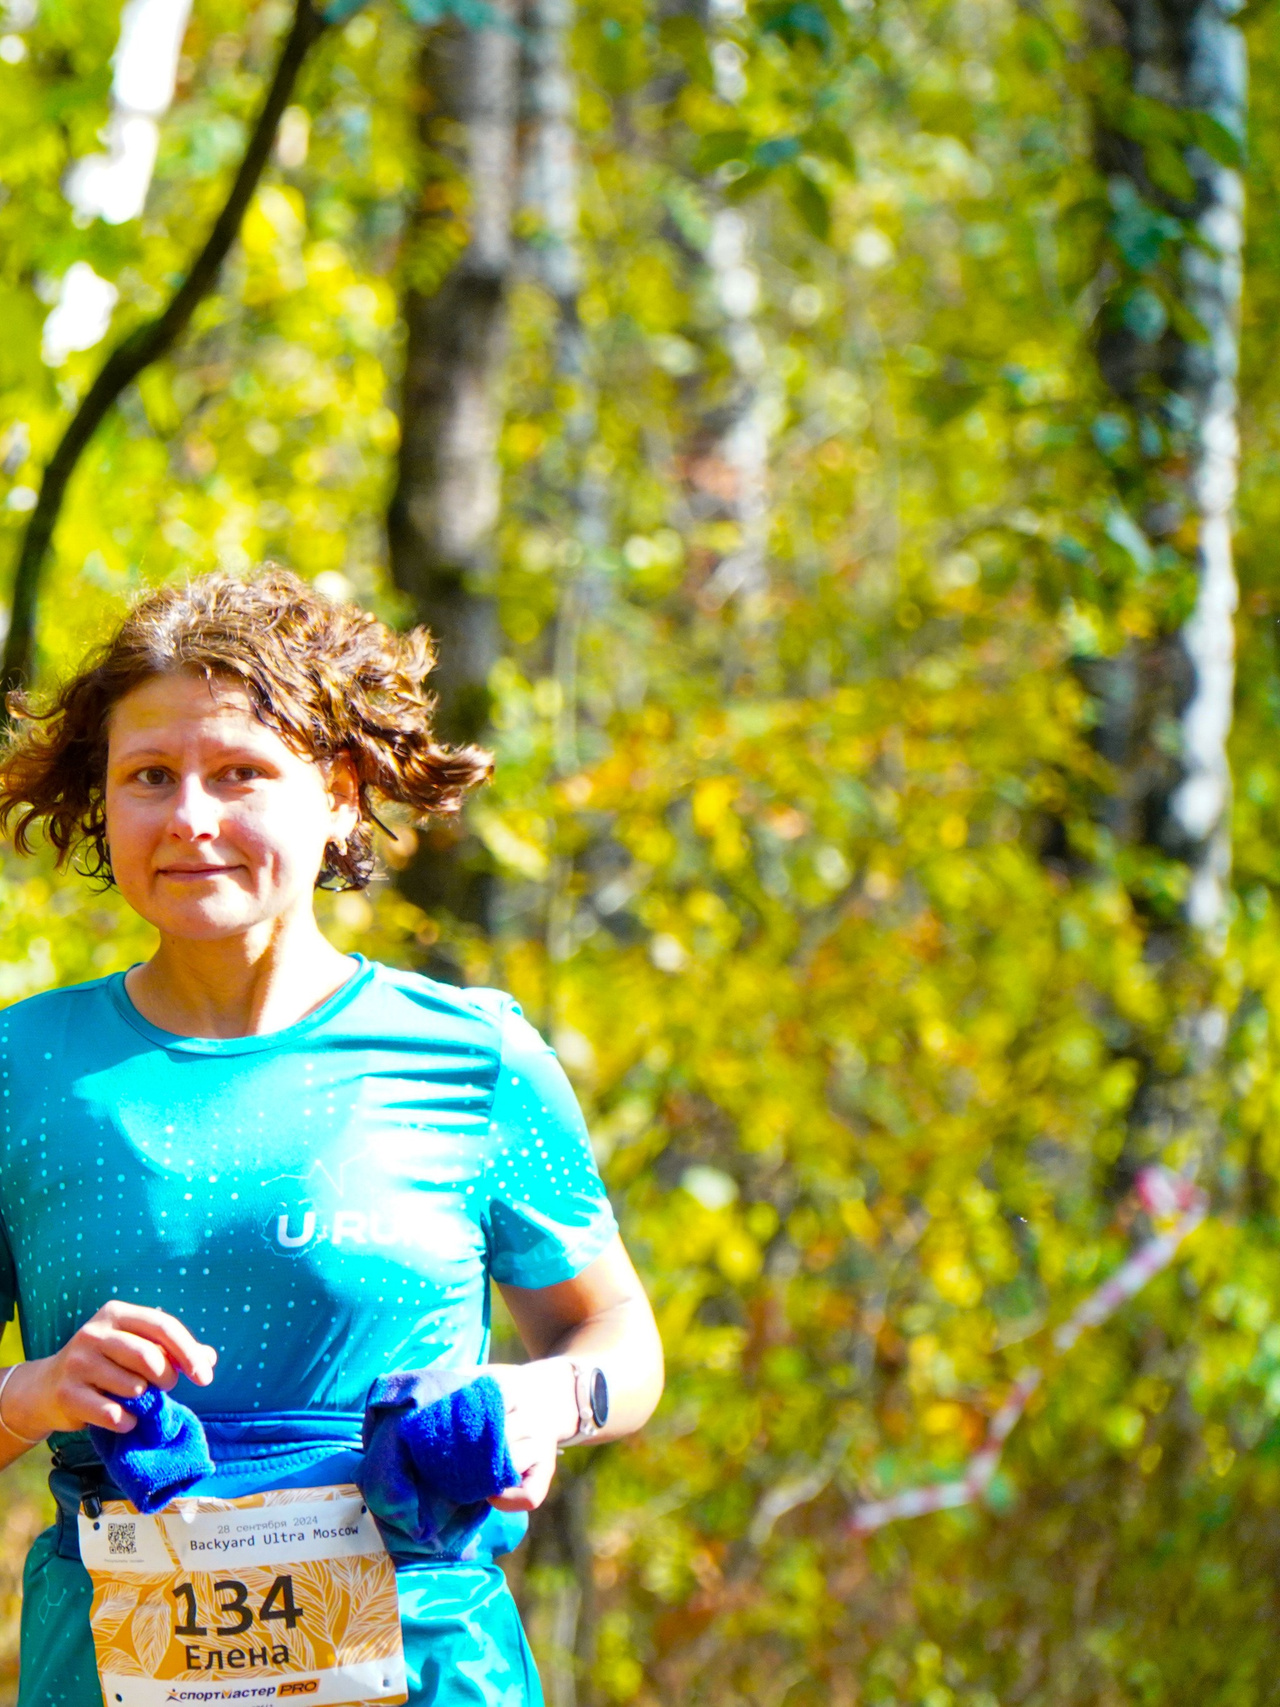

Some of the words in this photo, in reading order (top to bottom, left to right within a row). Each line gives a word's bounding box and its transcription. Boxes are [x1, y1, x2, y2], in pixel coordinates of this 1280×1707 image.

[277, 1211, 316, 1248] U
[217, 1525, 230, 1535] 28
[236, 1519, 287, 1533] сентября
[293, 1516, 318, 1527] 2024
[190, 1536, 255, 1551] Backyard
[263, 1532, 305, 1545] Ultra
[313, 1526, 359, 1539] Moscow
[172, 1575, 303, 1636] 134
[185, 1644, 289, 1670] Елена
[280, 1681, 317, 1695] PRO
